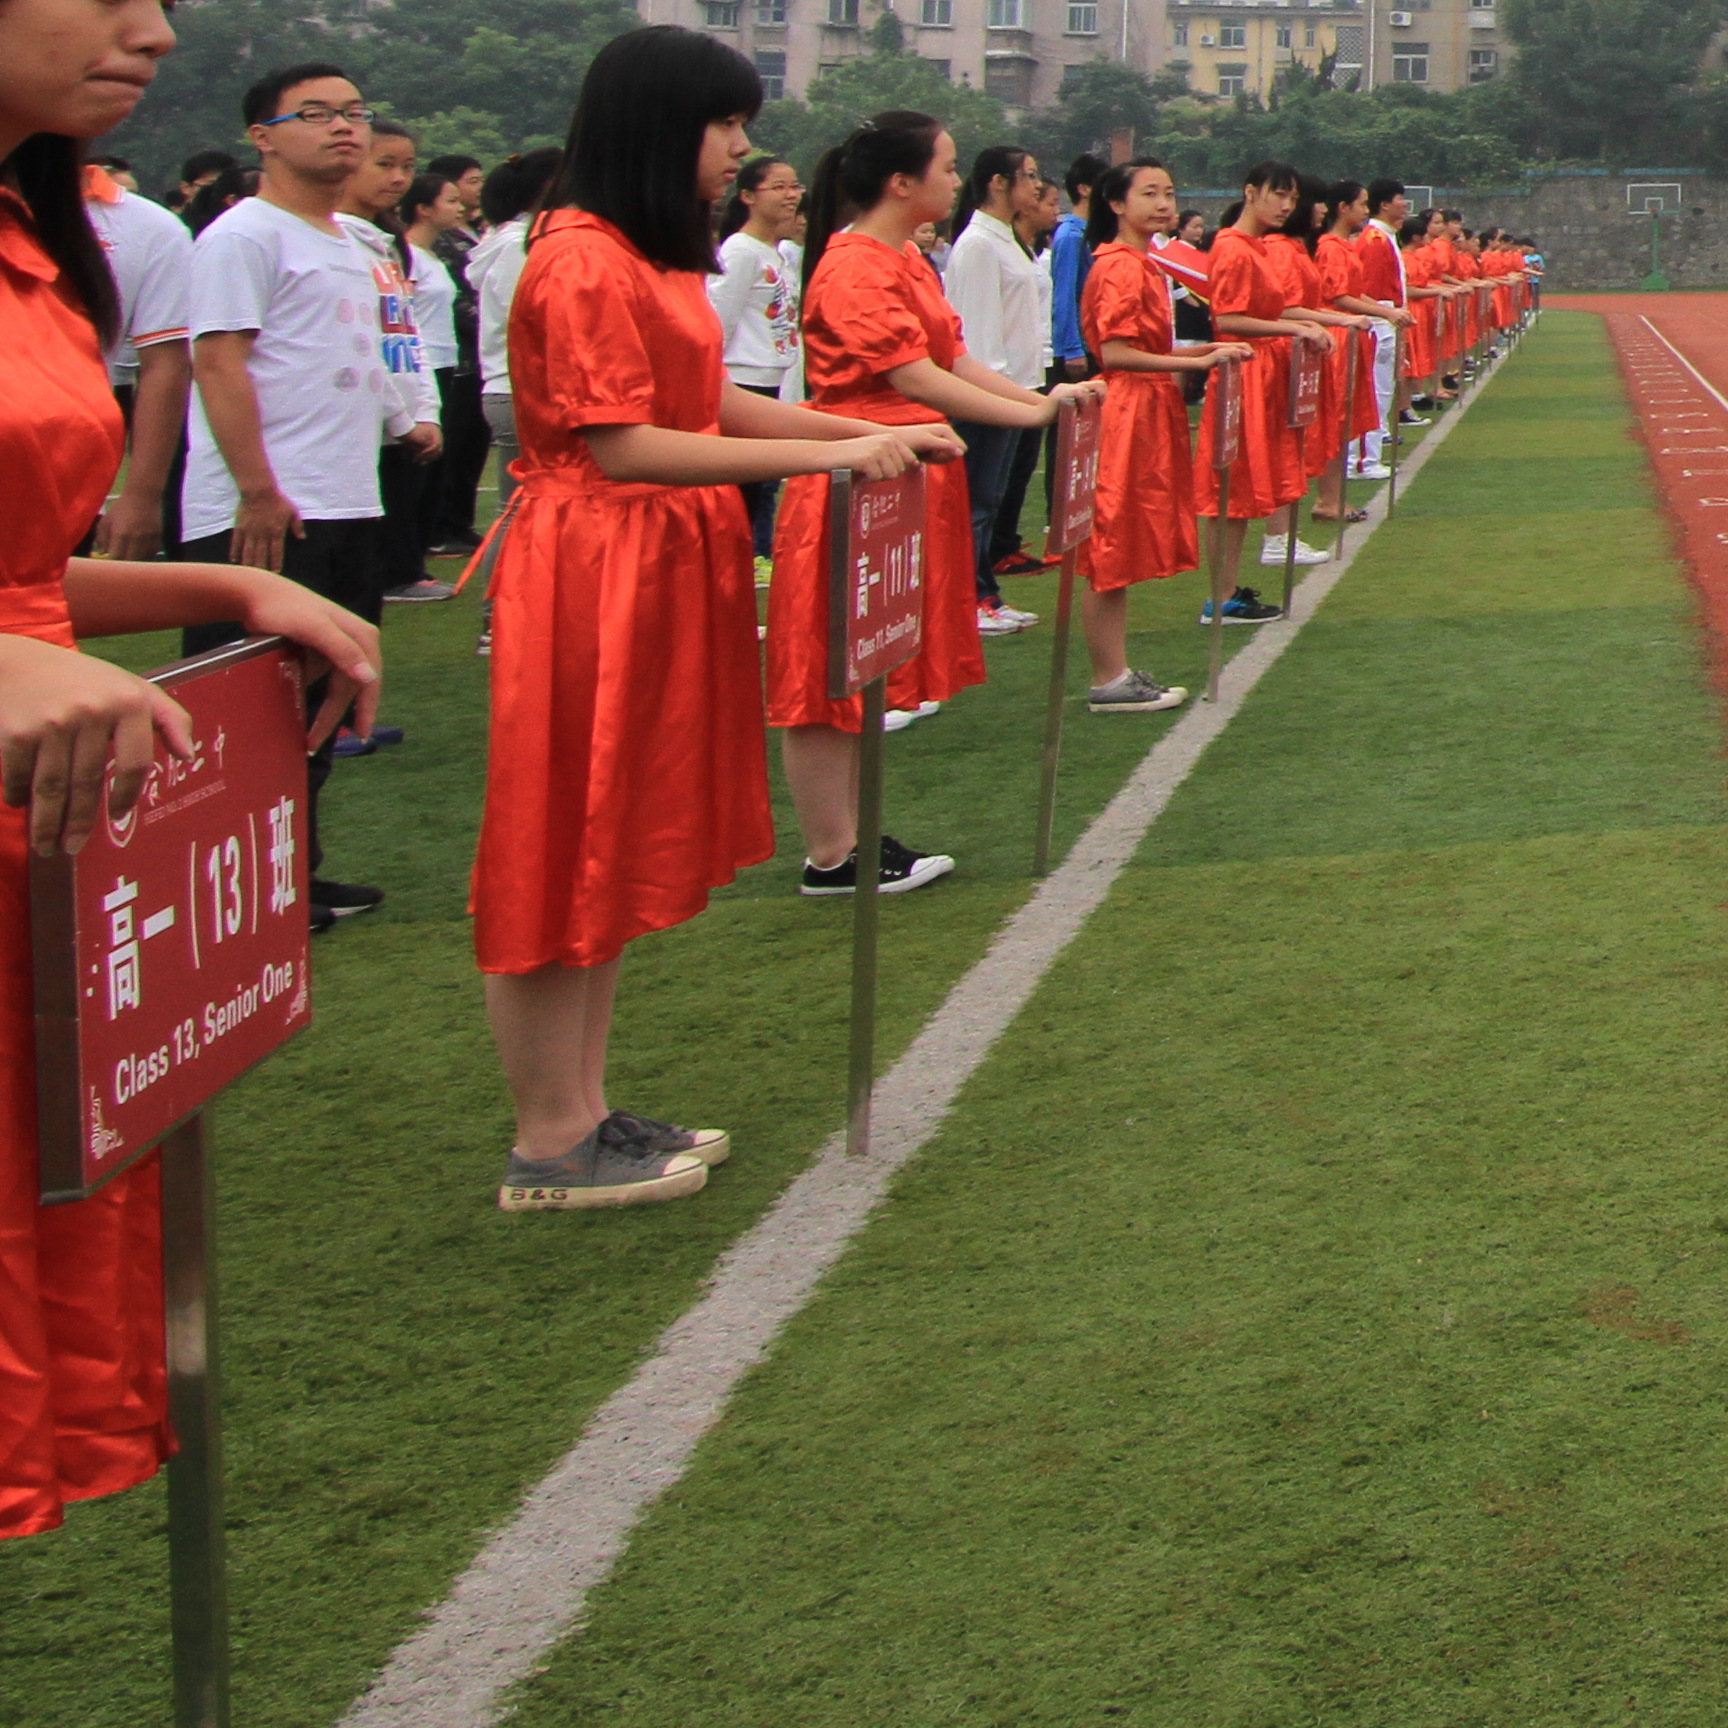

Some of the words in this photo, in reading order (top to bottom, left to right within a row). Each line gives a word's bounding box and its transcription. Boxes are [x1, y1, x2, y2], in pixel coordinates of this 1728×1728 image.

[103, 794, 296, 1021] 高一(13)班
[116, 1044, 169, 1105] Class
[173, 1017, 200, 1066] 13,
[204, 982, 260, 1045] Senior
[262, 960, 294, 1003] One
